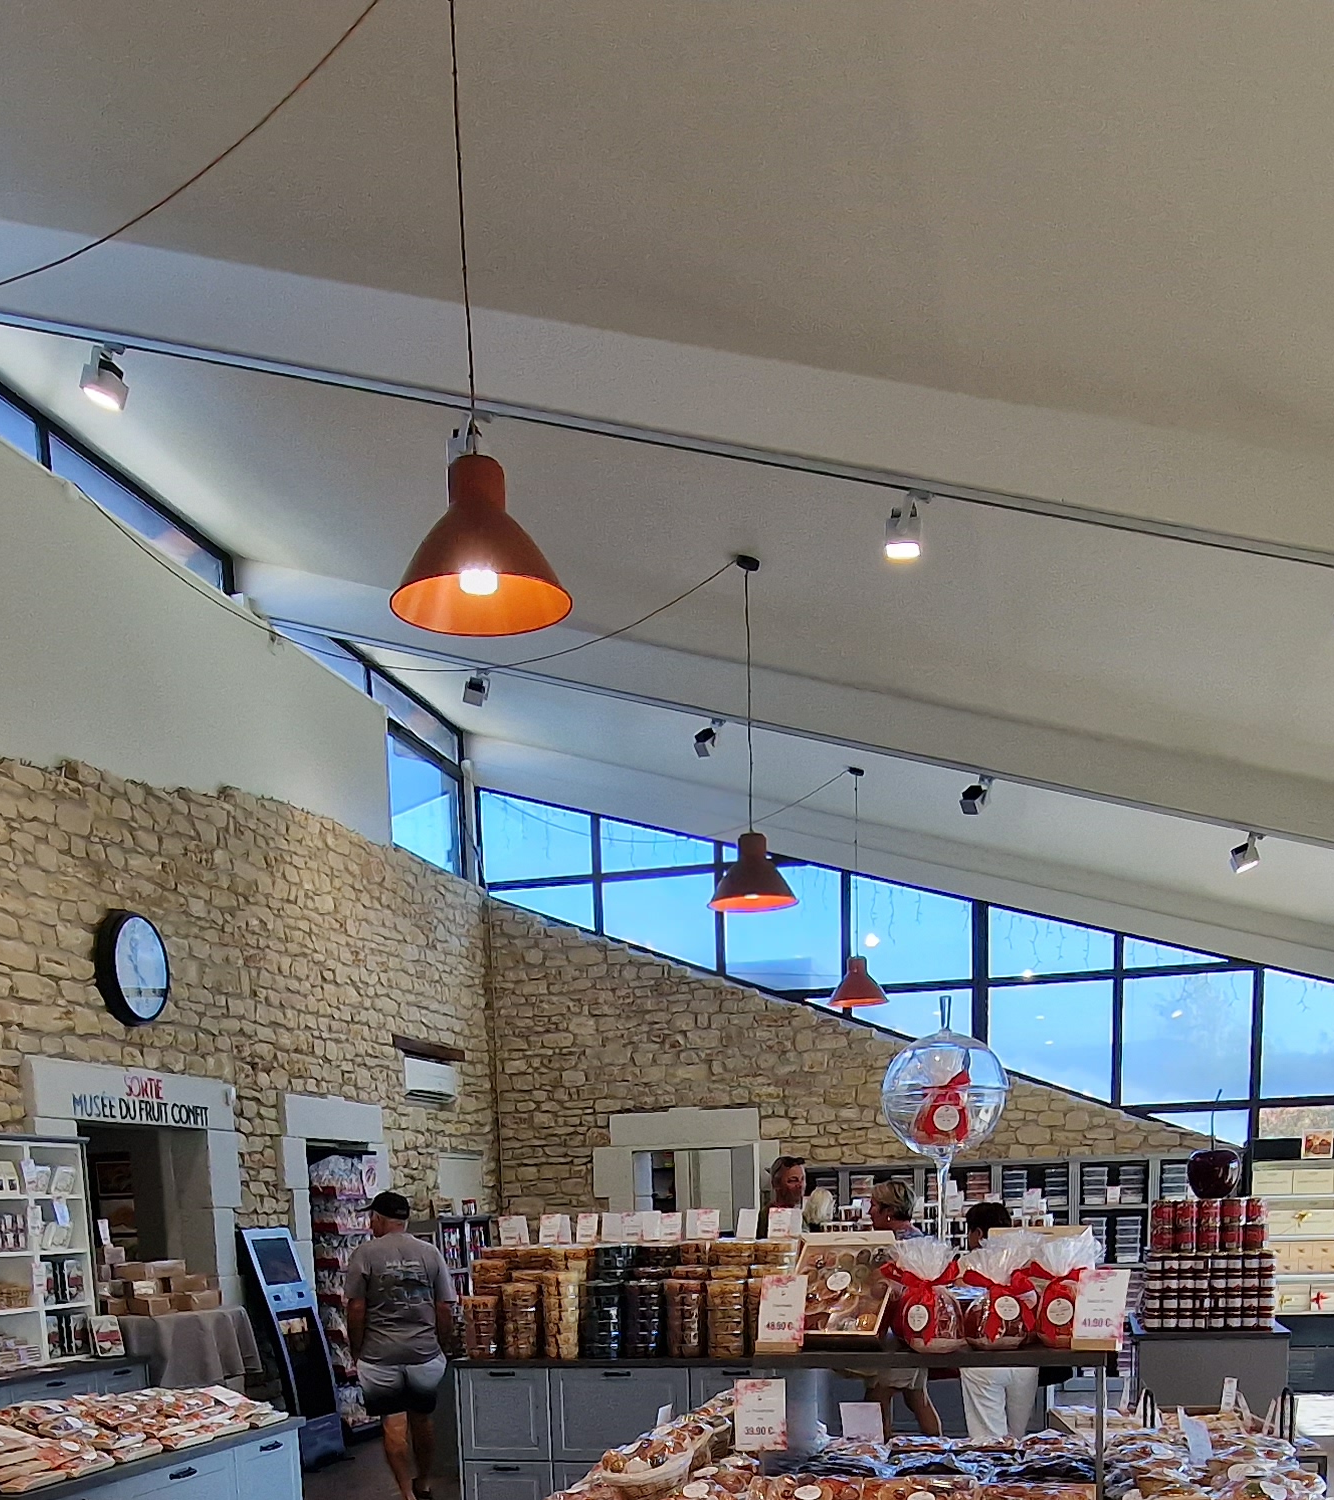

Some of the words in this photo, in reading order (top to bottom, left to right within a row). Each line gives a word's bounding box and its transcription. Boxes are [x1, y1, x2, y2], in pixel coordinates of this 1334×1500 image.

[123, 1075, 164, 1100] SORTIE
[71, 1091, 117, 1119] MUSÉE
[118, 1097, 137, 1121] DU
[138, 1099, 170, 1123] FRUIT
[171, 1102, 209, 1127] CONFIT
